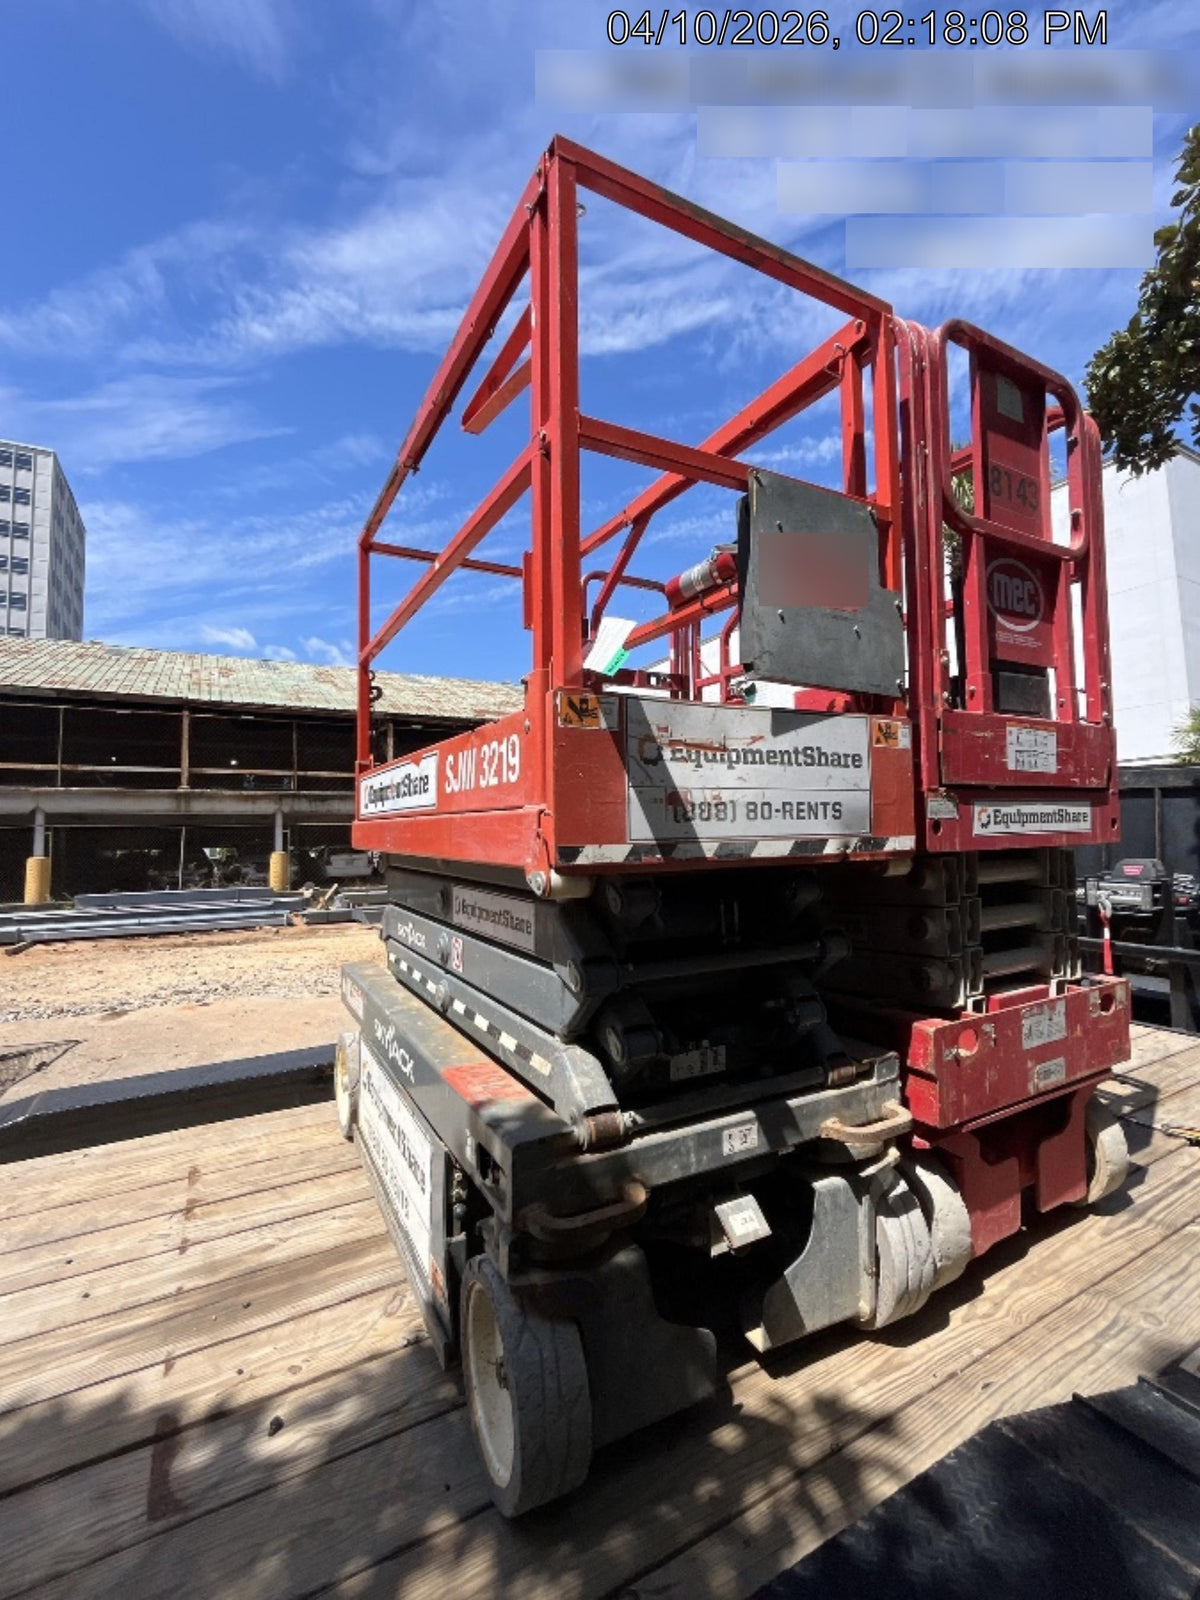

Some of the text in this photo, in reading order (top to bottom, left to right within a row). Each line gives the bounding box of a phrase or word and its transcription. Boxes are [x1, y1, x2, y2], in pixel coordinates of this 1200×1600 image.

[480, 733, 519, 788] 3219
[670, 746, 863, 770] EquipmentShare
[993, 808, 1089, 829] EquipmentShare
